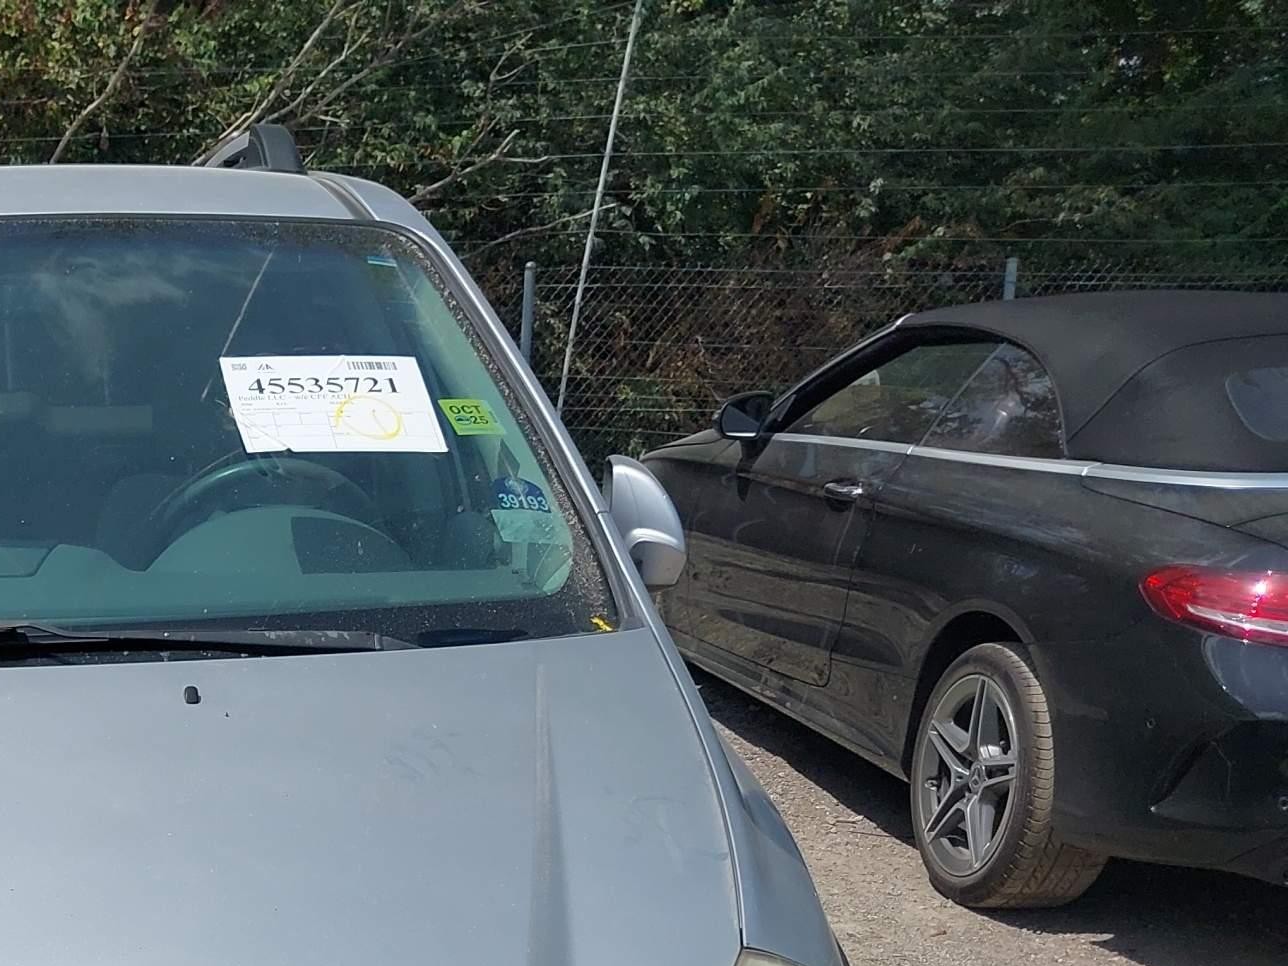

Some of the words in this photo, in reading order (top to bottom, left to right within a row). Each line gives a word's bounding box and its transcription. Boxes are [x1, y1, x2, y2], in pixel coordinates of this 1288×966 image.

[248, 377, 401, 395] 45535721
[449, 405, 481, 414] OCT
[470, 415, 489, 425] 25
[498, 493, 549, 511] 39193
